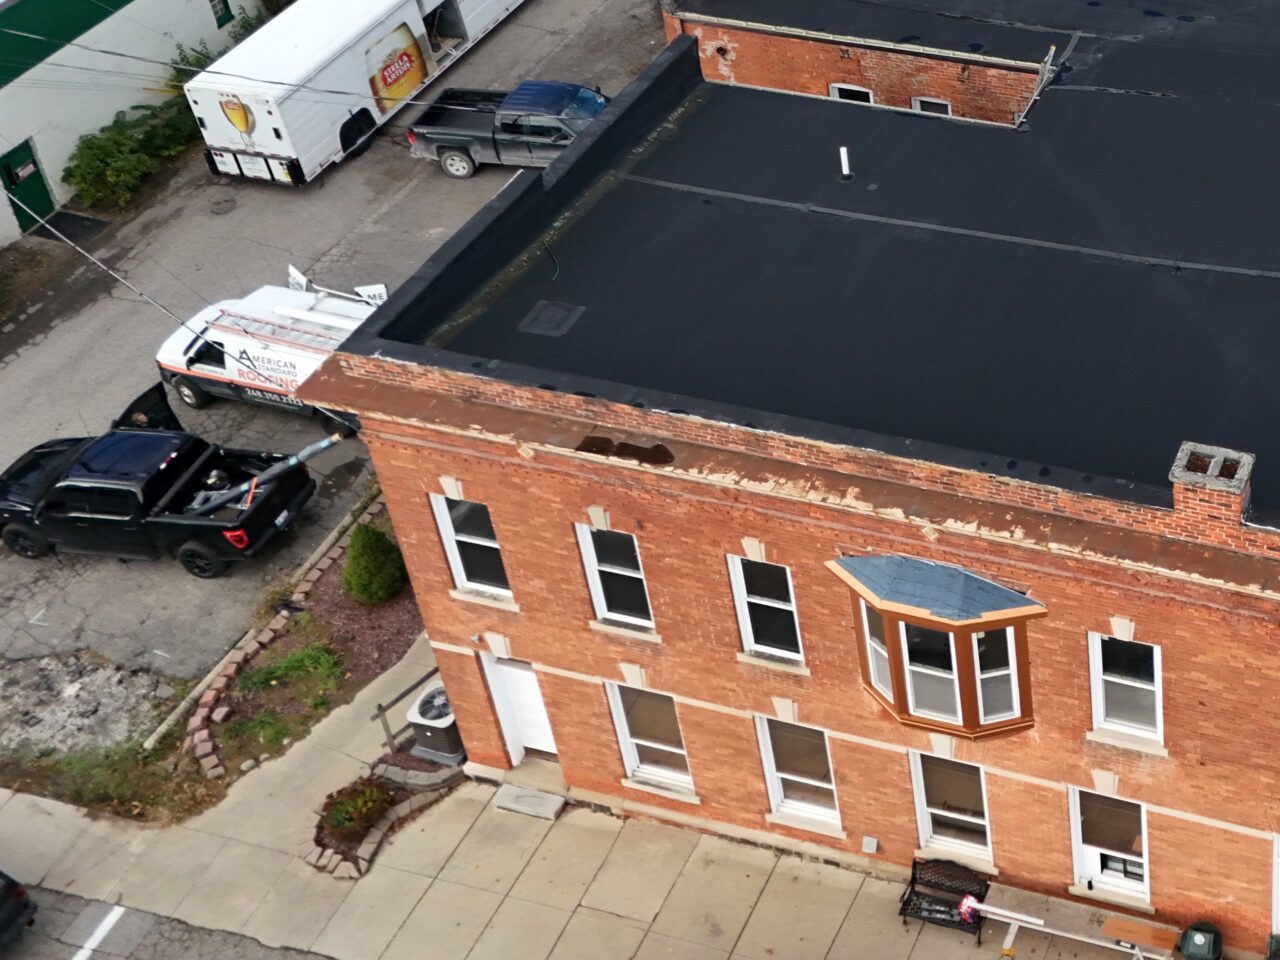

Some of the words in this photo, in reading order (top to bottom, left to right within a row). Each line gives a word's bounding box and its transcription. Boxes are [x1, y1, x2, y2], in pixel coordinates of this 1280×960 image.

[383, 55, 409, 77] STELLA
[386, 61, 411, 85] ARTOIS
[238, 348, 297, 370] AMERICAN
[236, 368, 299, 390] ROOFING
[257, 364, 298, 377] STANDARD
